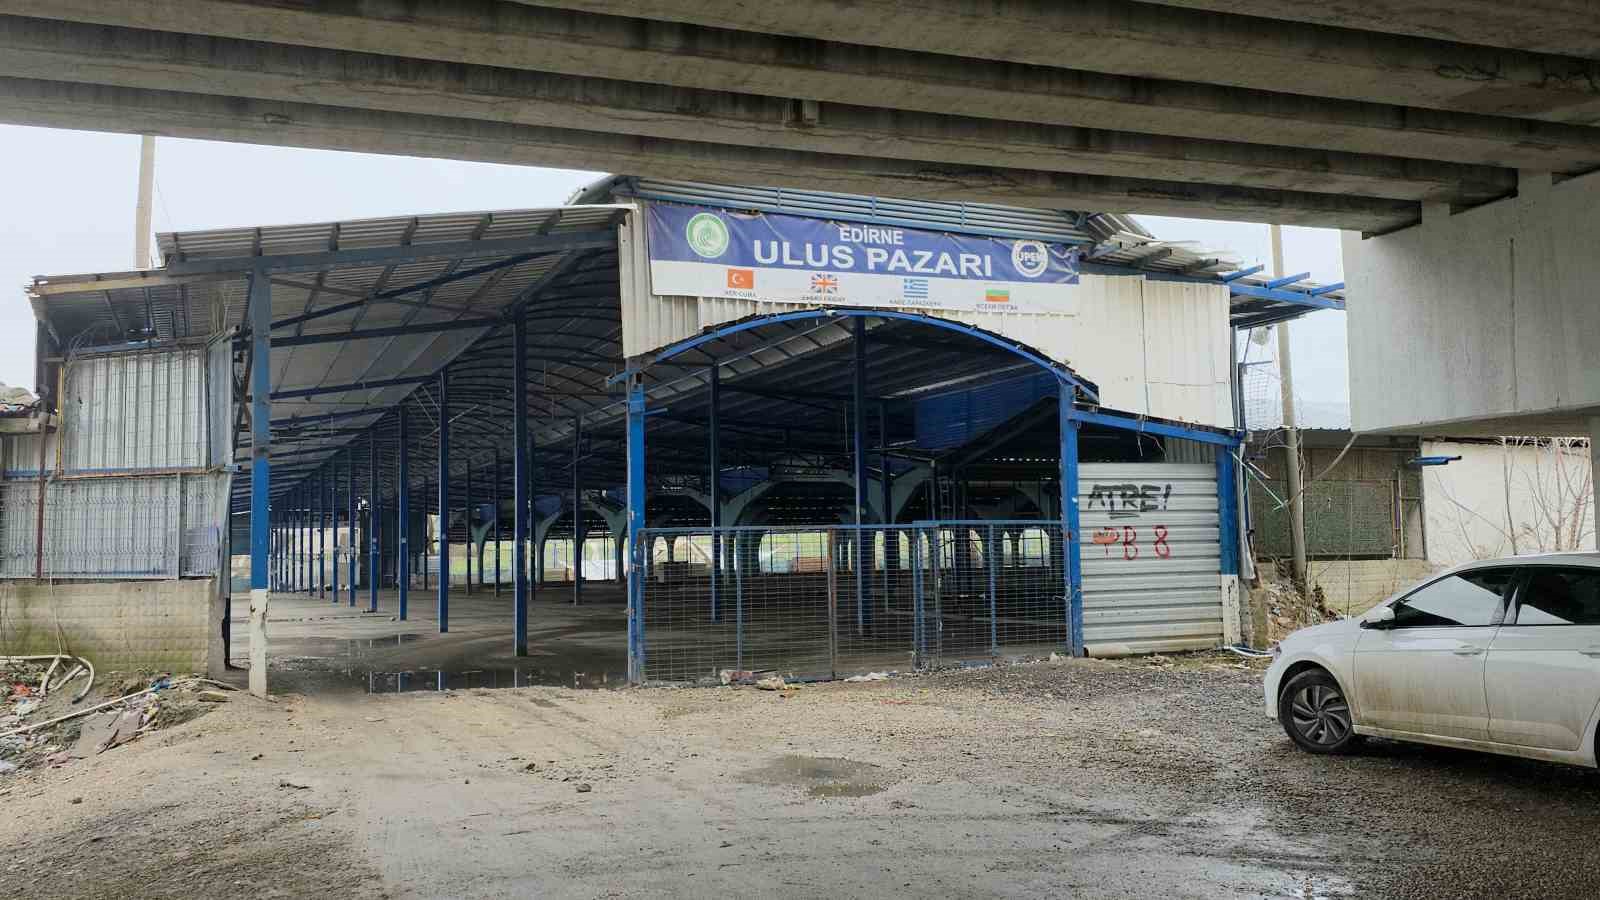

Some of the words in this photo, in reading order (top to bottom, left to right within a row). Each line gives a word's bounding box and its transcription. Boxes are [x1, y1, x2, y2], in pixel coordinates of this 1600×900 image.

[839, 225, 904, 246] EDİRNE
[753, 239, 855, 269] ULUS
[867, 248, 992, 277] PAZARI
